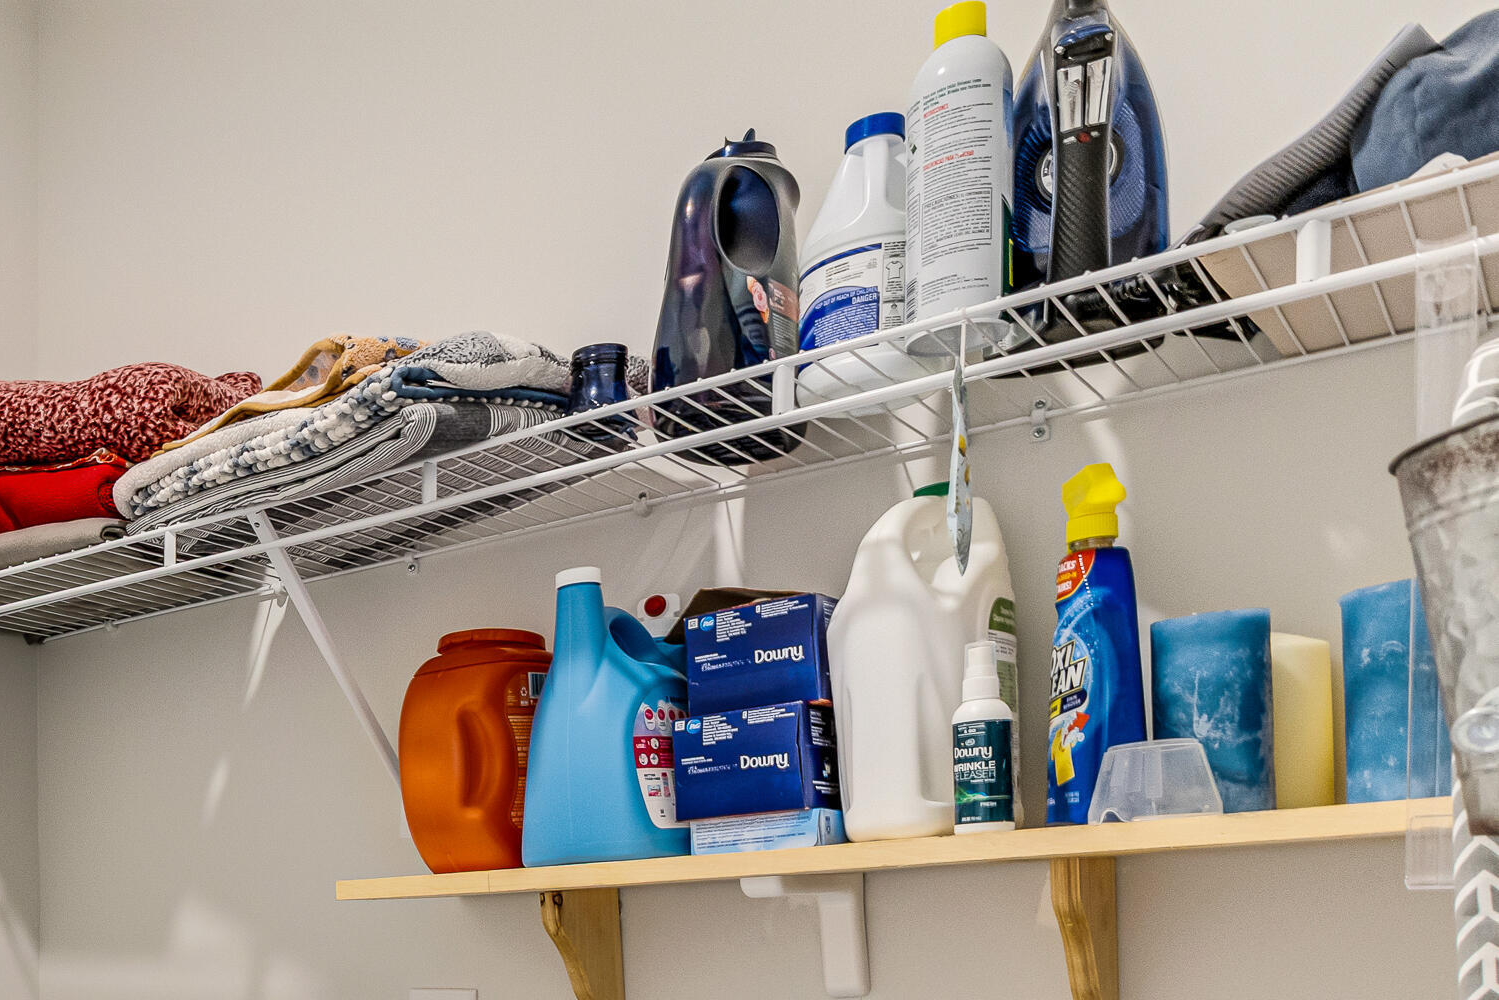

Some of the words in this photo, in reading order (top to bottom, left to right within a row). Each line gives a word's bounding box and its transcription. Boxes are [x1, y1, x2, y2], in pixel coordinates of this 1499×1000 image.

[851, 292, 878, 305] DANGER
[753, 644, 803, 665] Downy
[953, 745, 993, 759] Downy
[739, 752, 790, 771] Downy
